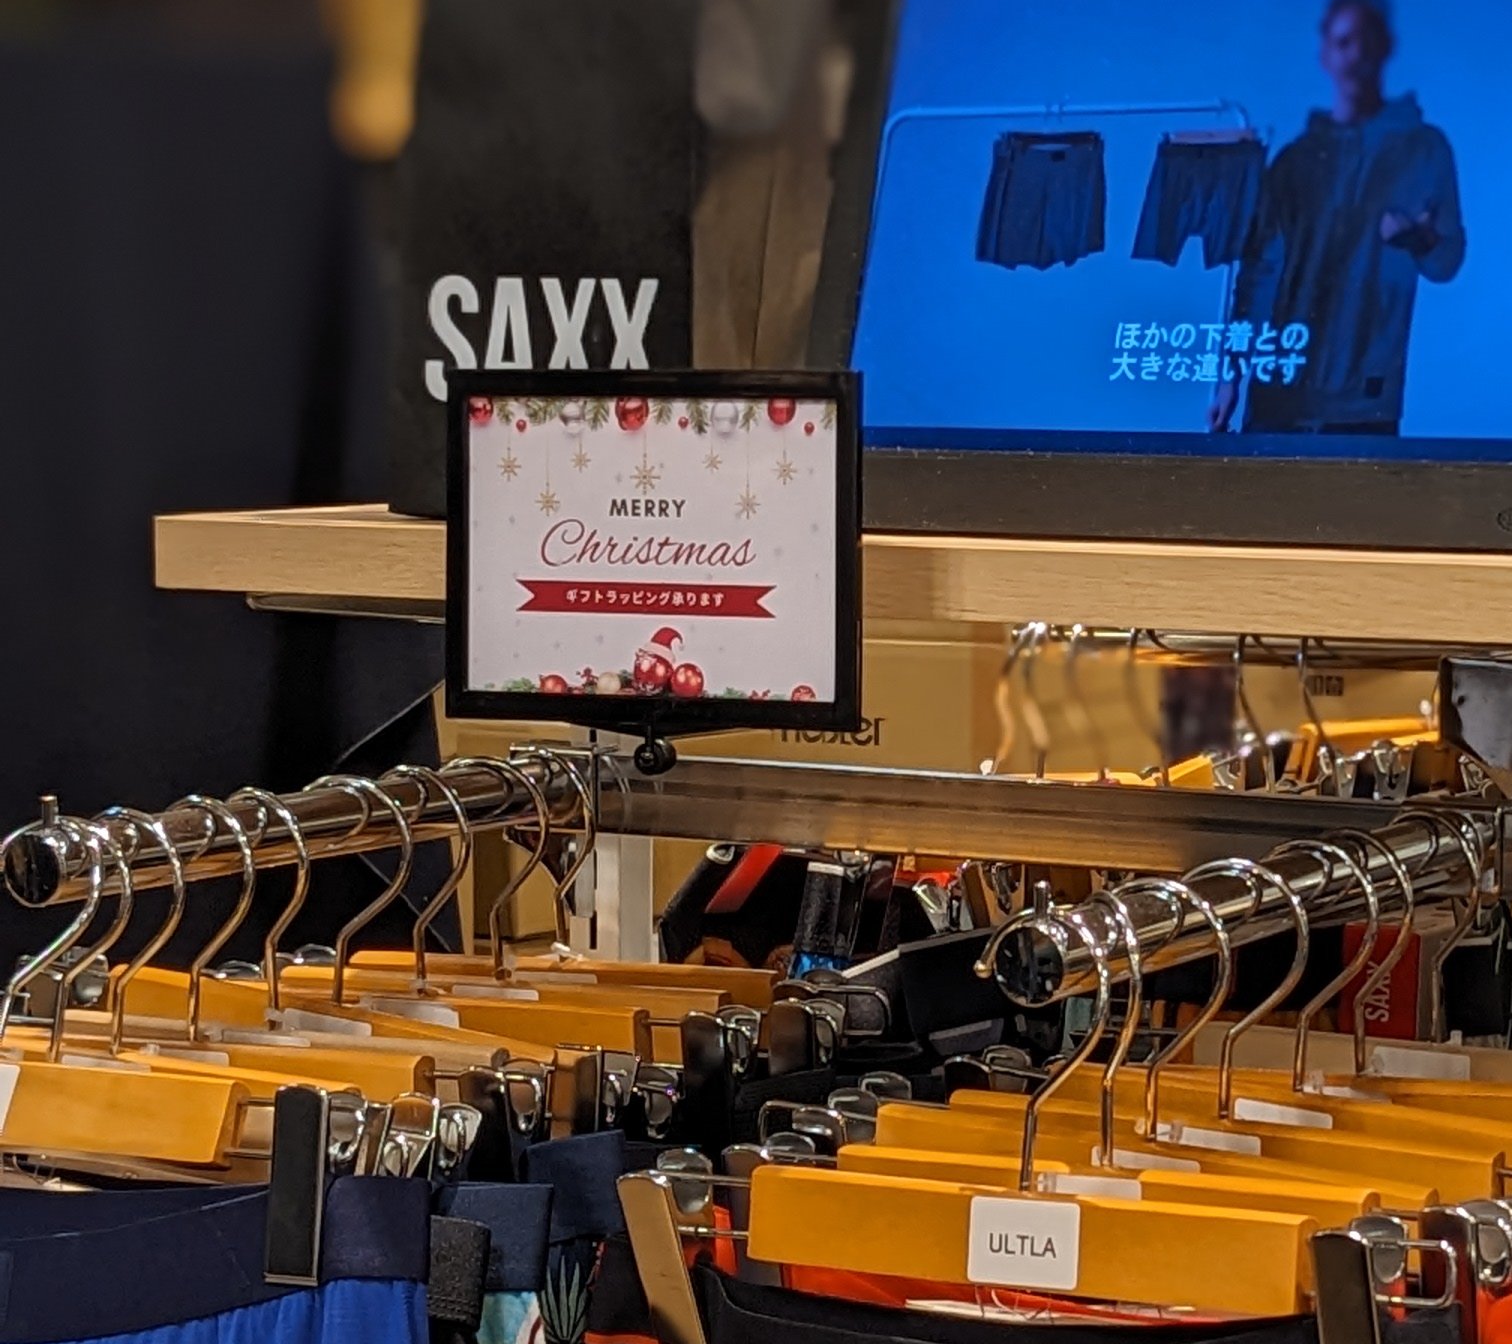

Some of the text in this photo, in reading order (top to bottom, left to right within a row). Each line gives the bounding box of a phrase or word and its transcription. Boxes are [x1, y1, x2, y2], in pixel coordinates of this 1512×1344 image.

[425, 274, 660, 402] SAXX
[1114, 321, 1310, 353] ほかの下着との
[1108, 351, 1307, 385] 大きな違いです
[608, 498, 687, 518] MERRY
[540, 518, 757, 568] Christmas
[565, 588, 725, 608] ギフトラッピング承ります
[989, 1231, 1058, 1260] ULTLA
